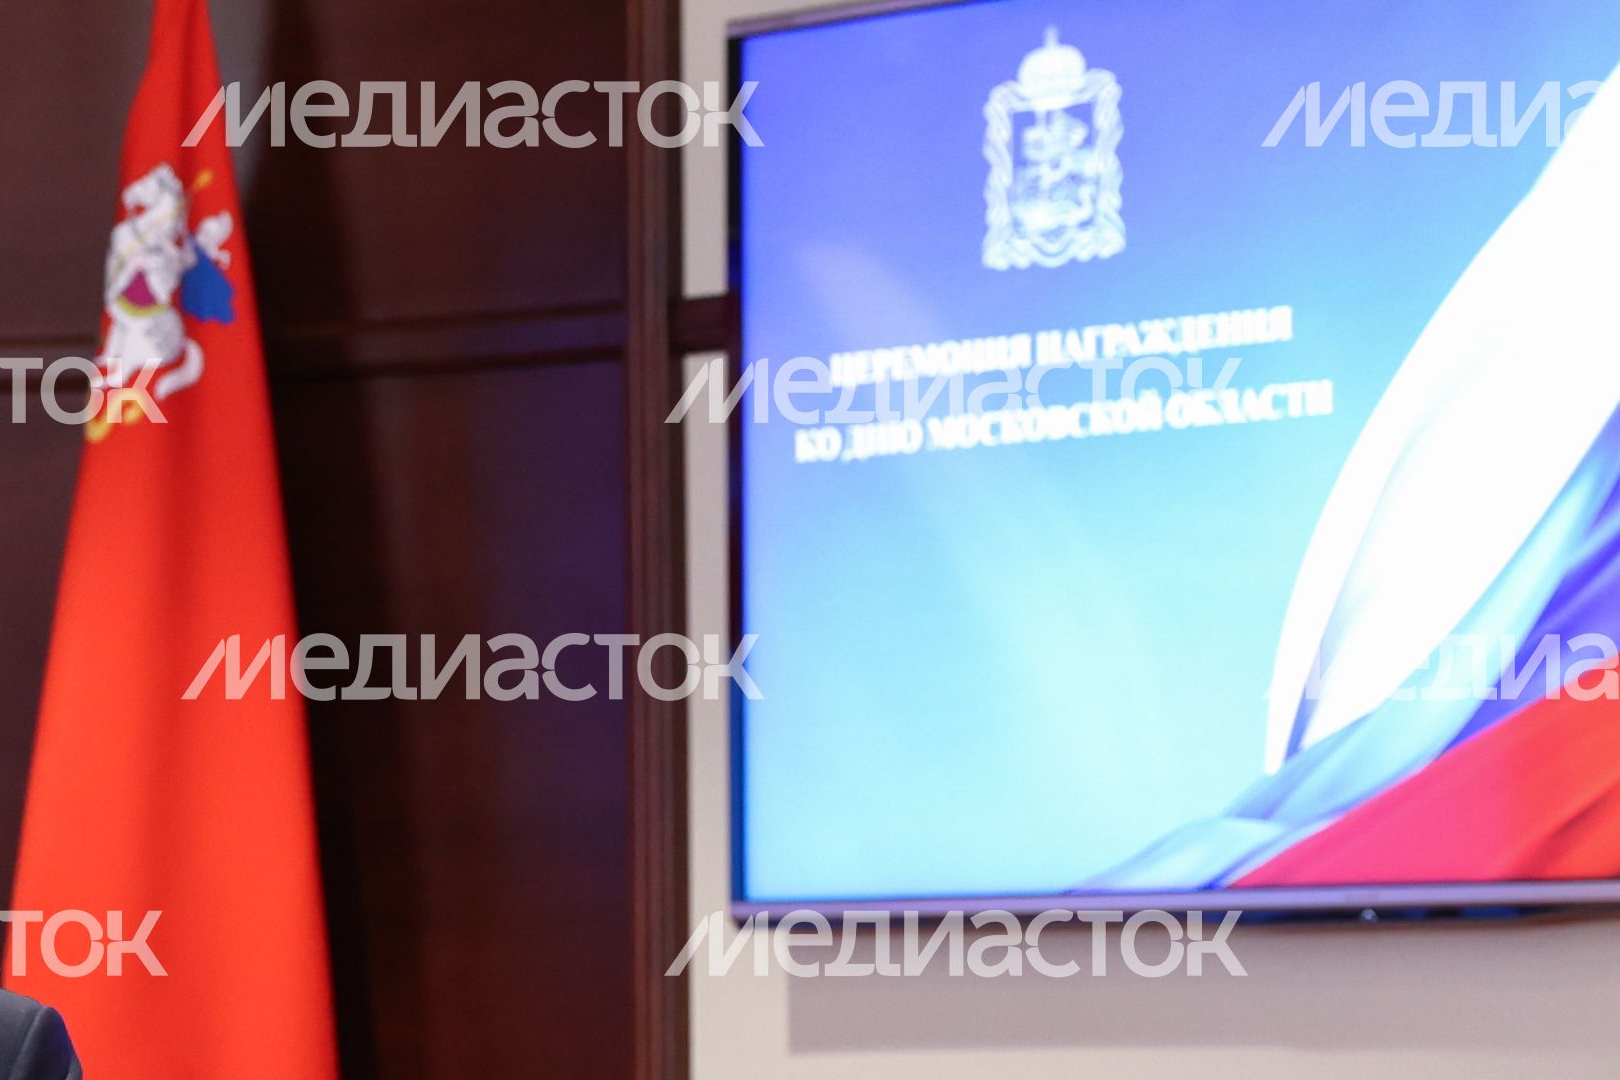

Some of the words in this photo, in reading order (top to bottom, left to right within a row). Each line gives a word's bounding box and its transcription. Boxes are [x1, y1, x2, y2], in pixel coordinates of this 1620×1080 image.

[830, 332, 1031, 389] ЦЕРЕМОНИЯ
[1035, 305, 1293, 368] НАГРАЖДЕНИЯ
[794, 426, 842, 463] КО
[926, 388, 1164, 451] МОСКОВСКОЙ
[1165, 378, 1334, 430] ОБЛАСТИ
